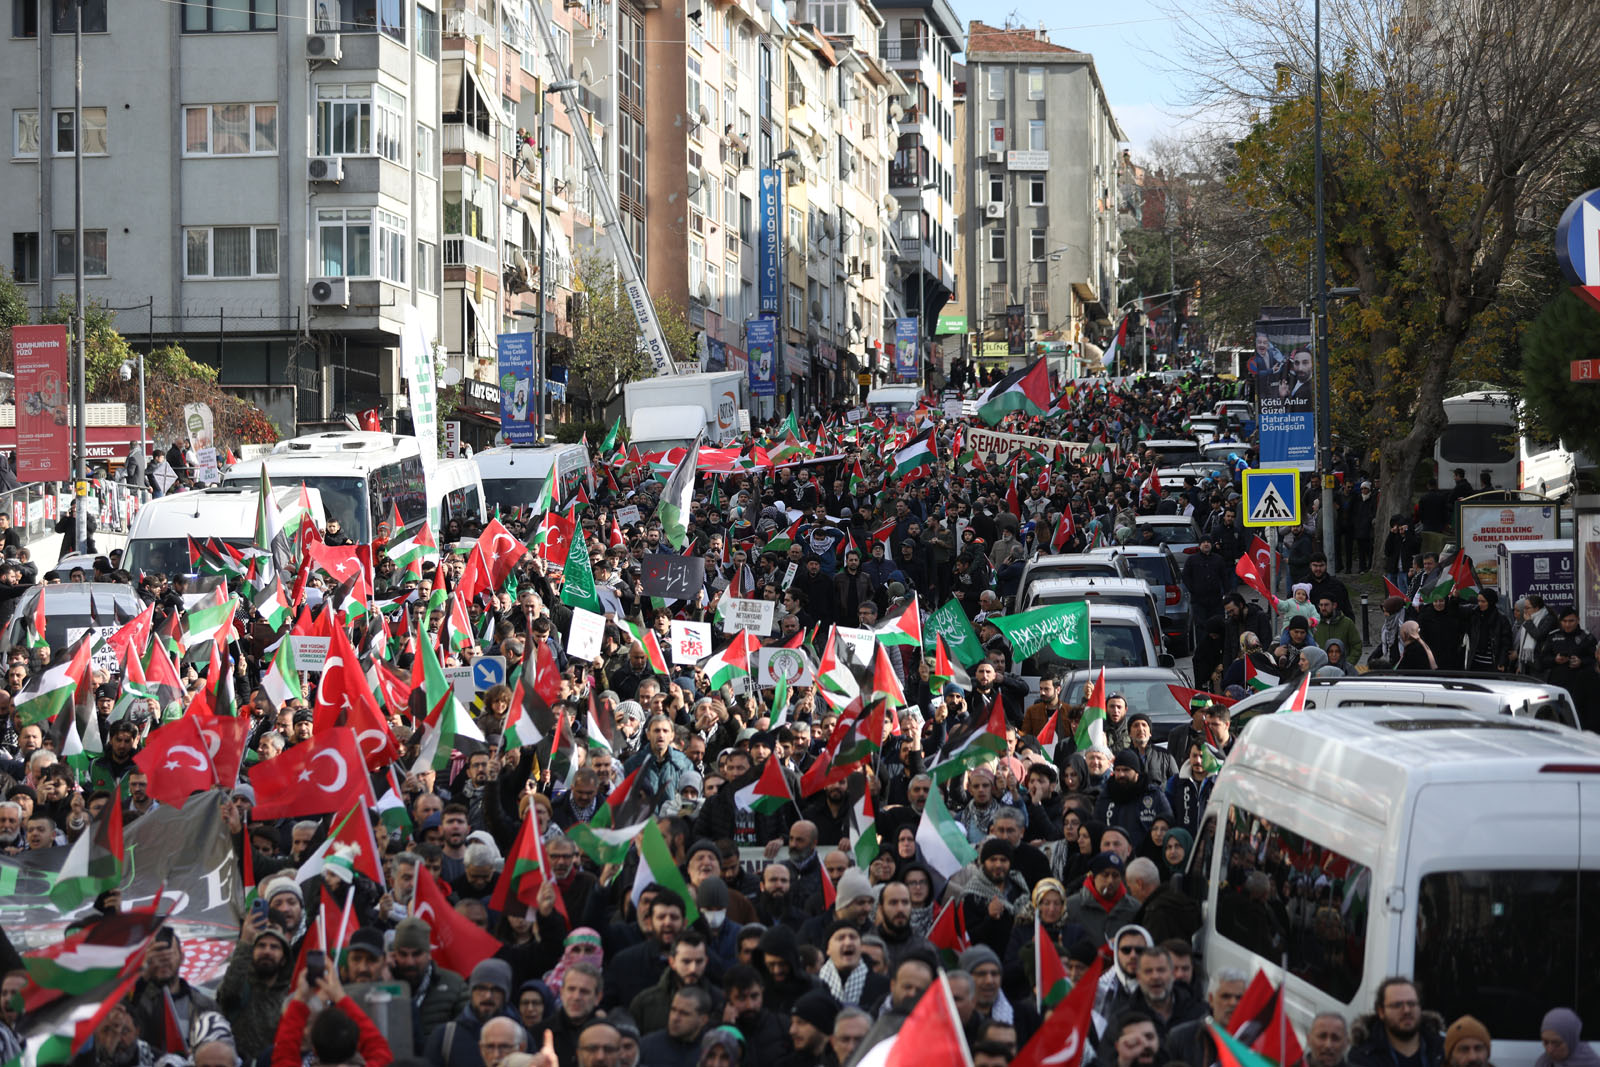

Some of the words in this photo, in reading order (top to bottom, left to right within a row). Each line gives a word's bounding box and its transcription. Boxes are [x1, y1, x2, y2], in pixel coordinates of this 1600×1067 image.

[767, 194, 775, 292] boğaziçi
[16, 348, 32, 356] YÜZÜ
[1260, 398, 1282, 407] Kötü
[1285, 397, 1308, 406] Anlar
[1261, 406, 1286, 415] Güzel
[1261, 414, 1304, 424] Hatıralara
[1262, 422, 1305, 433] Dönüşsün
[446, 423, 455, 459] PETS
[1481, 526, 1512, 534] BURGER
[1512, 526, 1533, 534] KING
[1472, 533, 1503, 543] ÖNEMLE
[1529, 583, 1549, 591] ATIK
[680, 640, 703, 649] SUS
[680, 647, 703, 657] MA!
